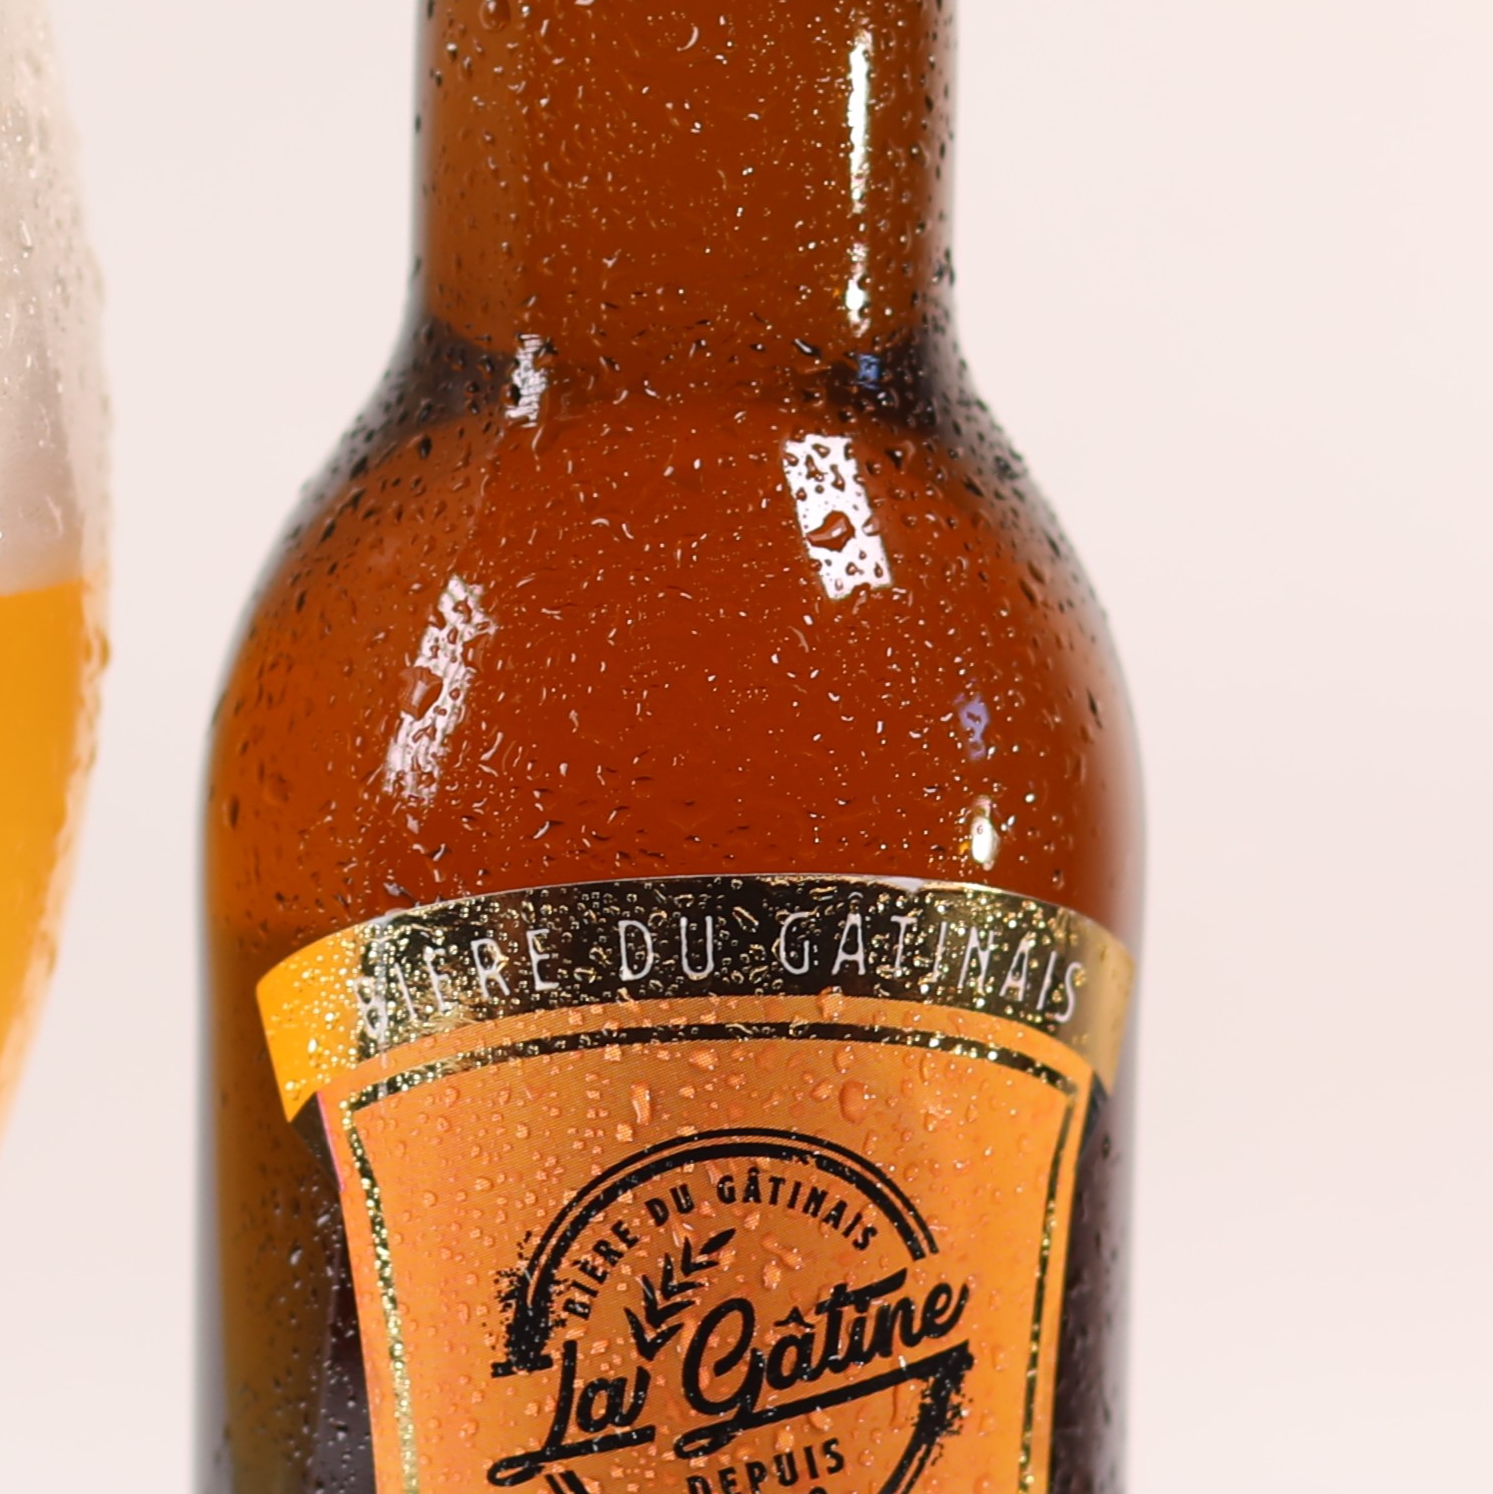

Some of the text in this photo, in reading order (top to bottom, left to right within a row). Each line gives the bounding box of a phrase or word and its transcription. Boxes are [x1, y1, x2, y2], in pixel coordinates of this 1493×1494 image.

[617, 913, 715, 982] DU
[778, 892, 1083, 1023] GÂTINAIS
[562, 1167, 880, 1321] BIÈRE DU GÂTINAIS
[487, 1268, 970, 1487] La Gâtine
